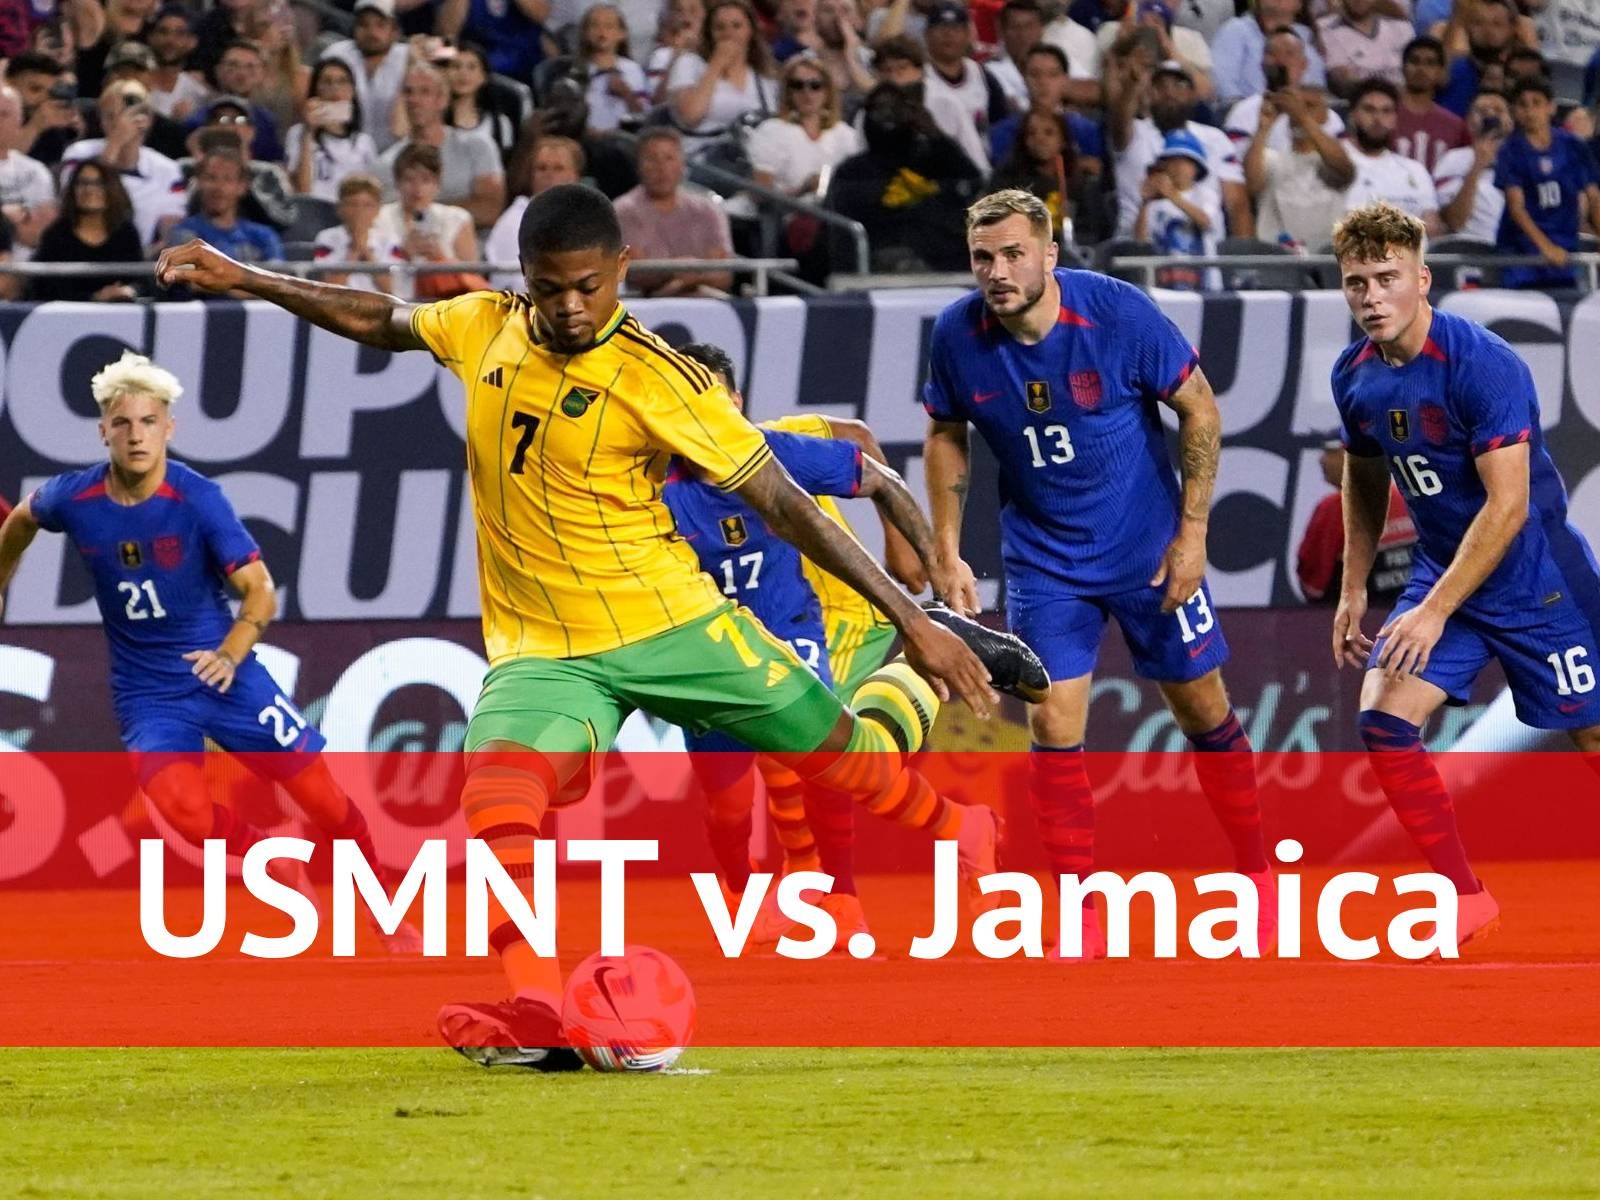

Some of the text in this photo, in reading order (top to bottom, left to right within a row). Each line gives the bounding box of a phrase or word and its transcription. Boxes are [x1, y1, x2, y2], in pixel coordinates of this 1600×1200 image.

[509, 410, 541, 475] 7
[1023, 424, 1076, 468] 13
[1393, 454, 1444, 497] 16
[720, 551, 764, 595] 17
[117, 579, 167, 620] 21
[1175, 587, 1214, 643] 13
[706, 612, 763, 668] 7
[1547, 645, 1596, 696] 16
[258, 693, 307, 748] 21
